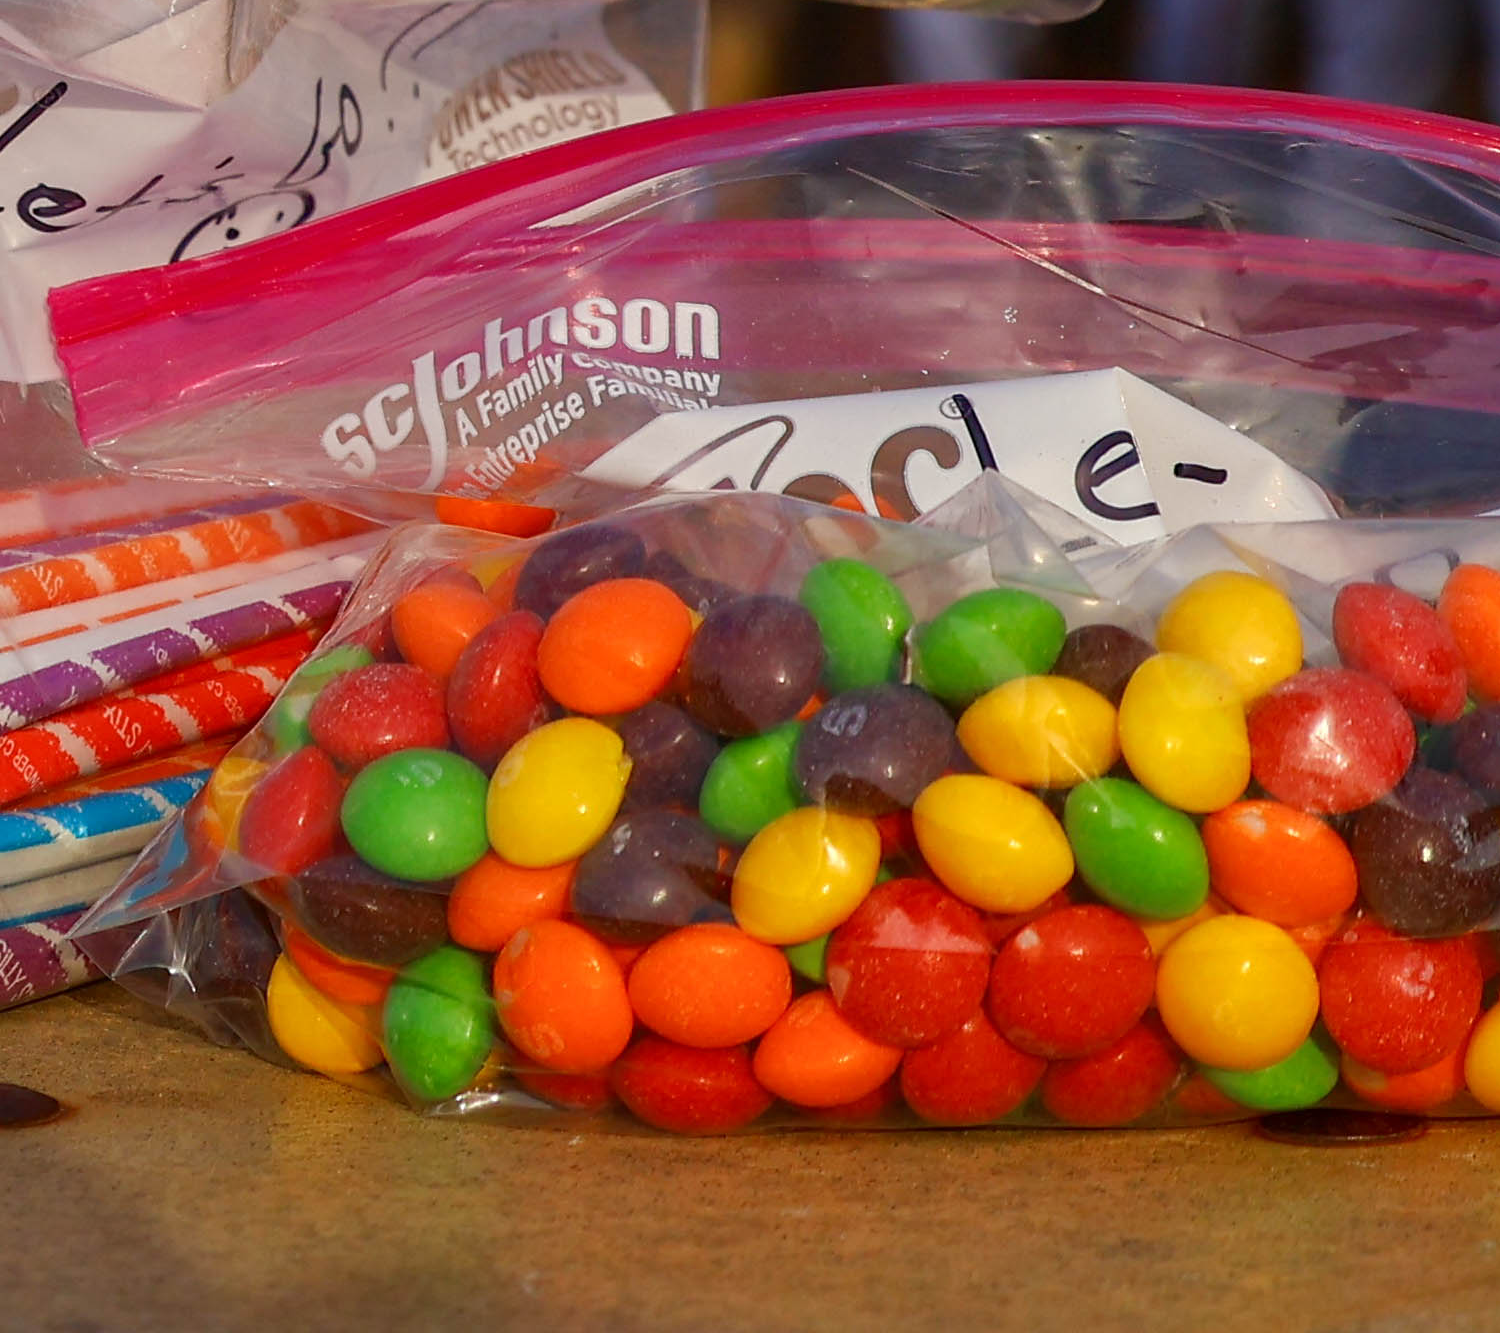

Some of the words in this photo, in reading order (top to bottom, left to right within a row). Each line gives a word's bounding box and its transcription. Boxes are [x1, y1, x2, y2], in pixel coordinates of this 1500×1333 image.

[447, 93, 621, 171] Technology
[455, 407, 478, 448] A
[475, 352, 565, 430] Family
[570, 351, 721, 398] Company
[464, 389, 586, 491] Entreprise
